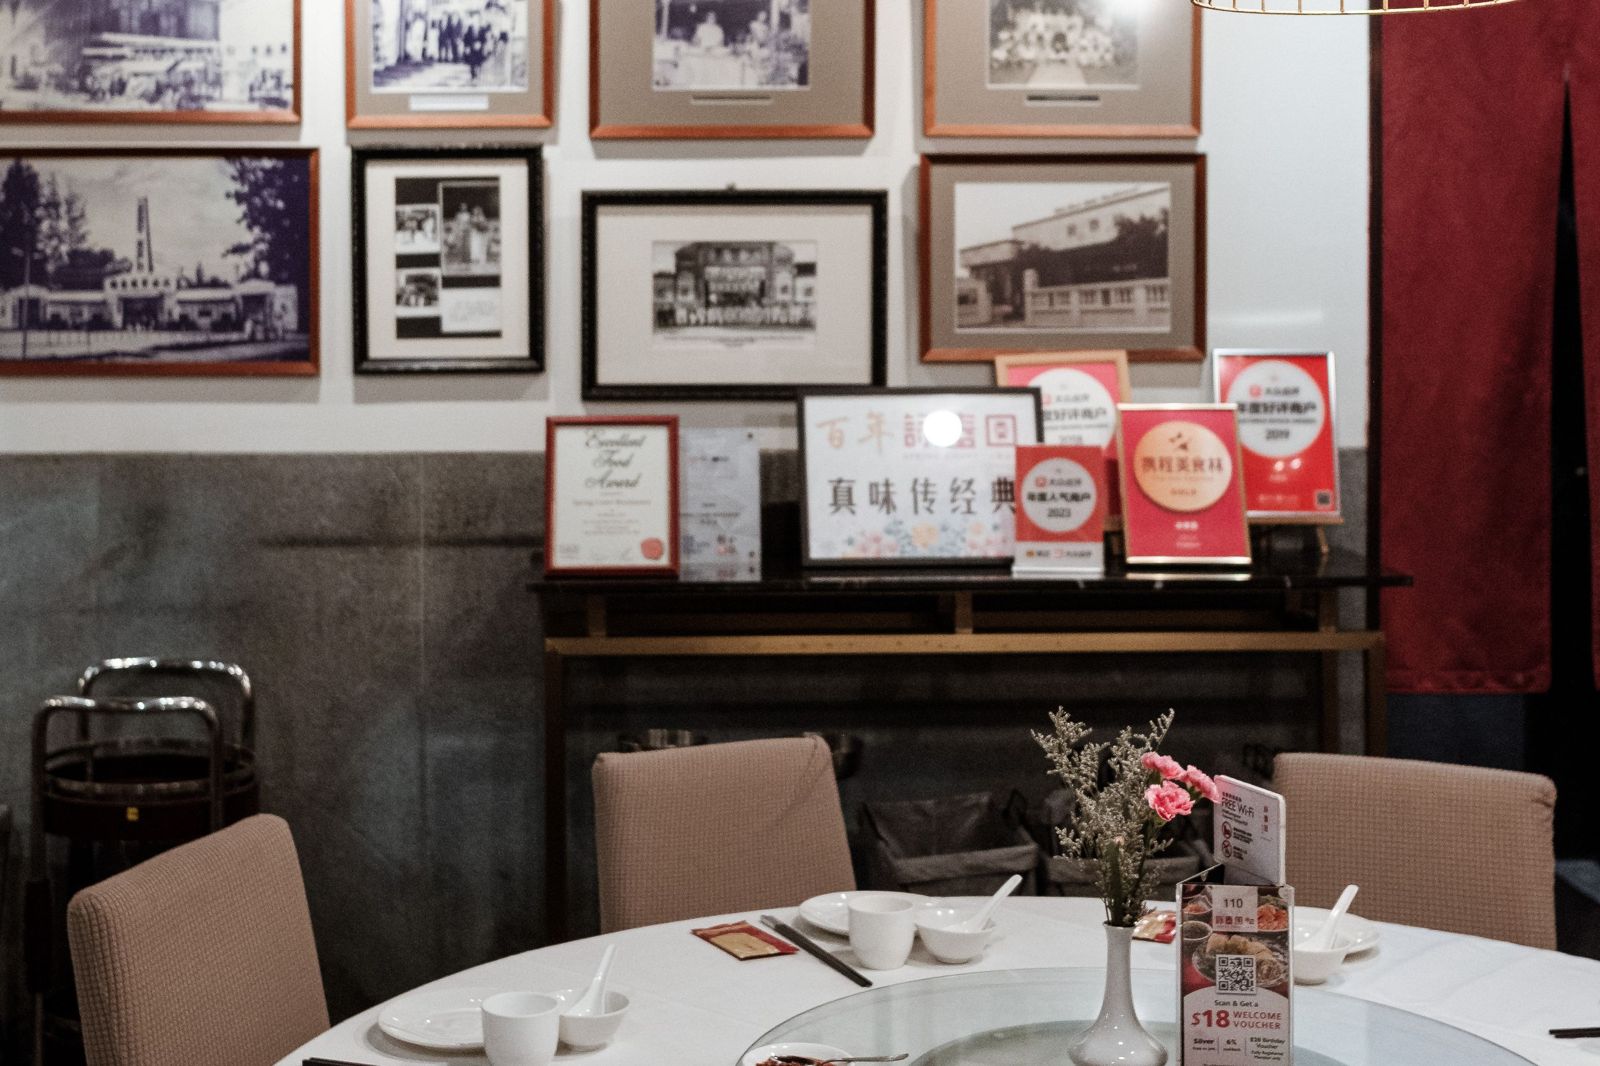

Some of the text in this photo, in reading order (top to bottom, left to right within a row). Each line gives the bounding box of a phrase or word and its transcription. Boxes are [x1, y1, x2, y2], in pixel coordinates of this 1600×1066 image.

[827, 476, 1016, 516] 真味传经典
[1221, 797, 1236, 811] FREE
[1224, 898, 1243, 908] 110
[1191, 1009, 1230, 1028] $18
[1233, 1011, 1282, 1020] WELCOME
[1233, 1021, 1281, 1029] VOUCHER
